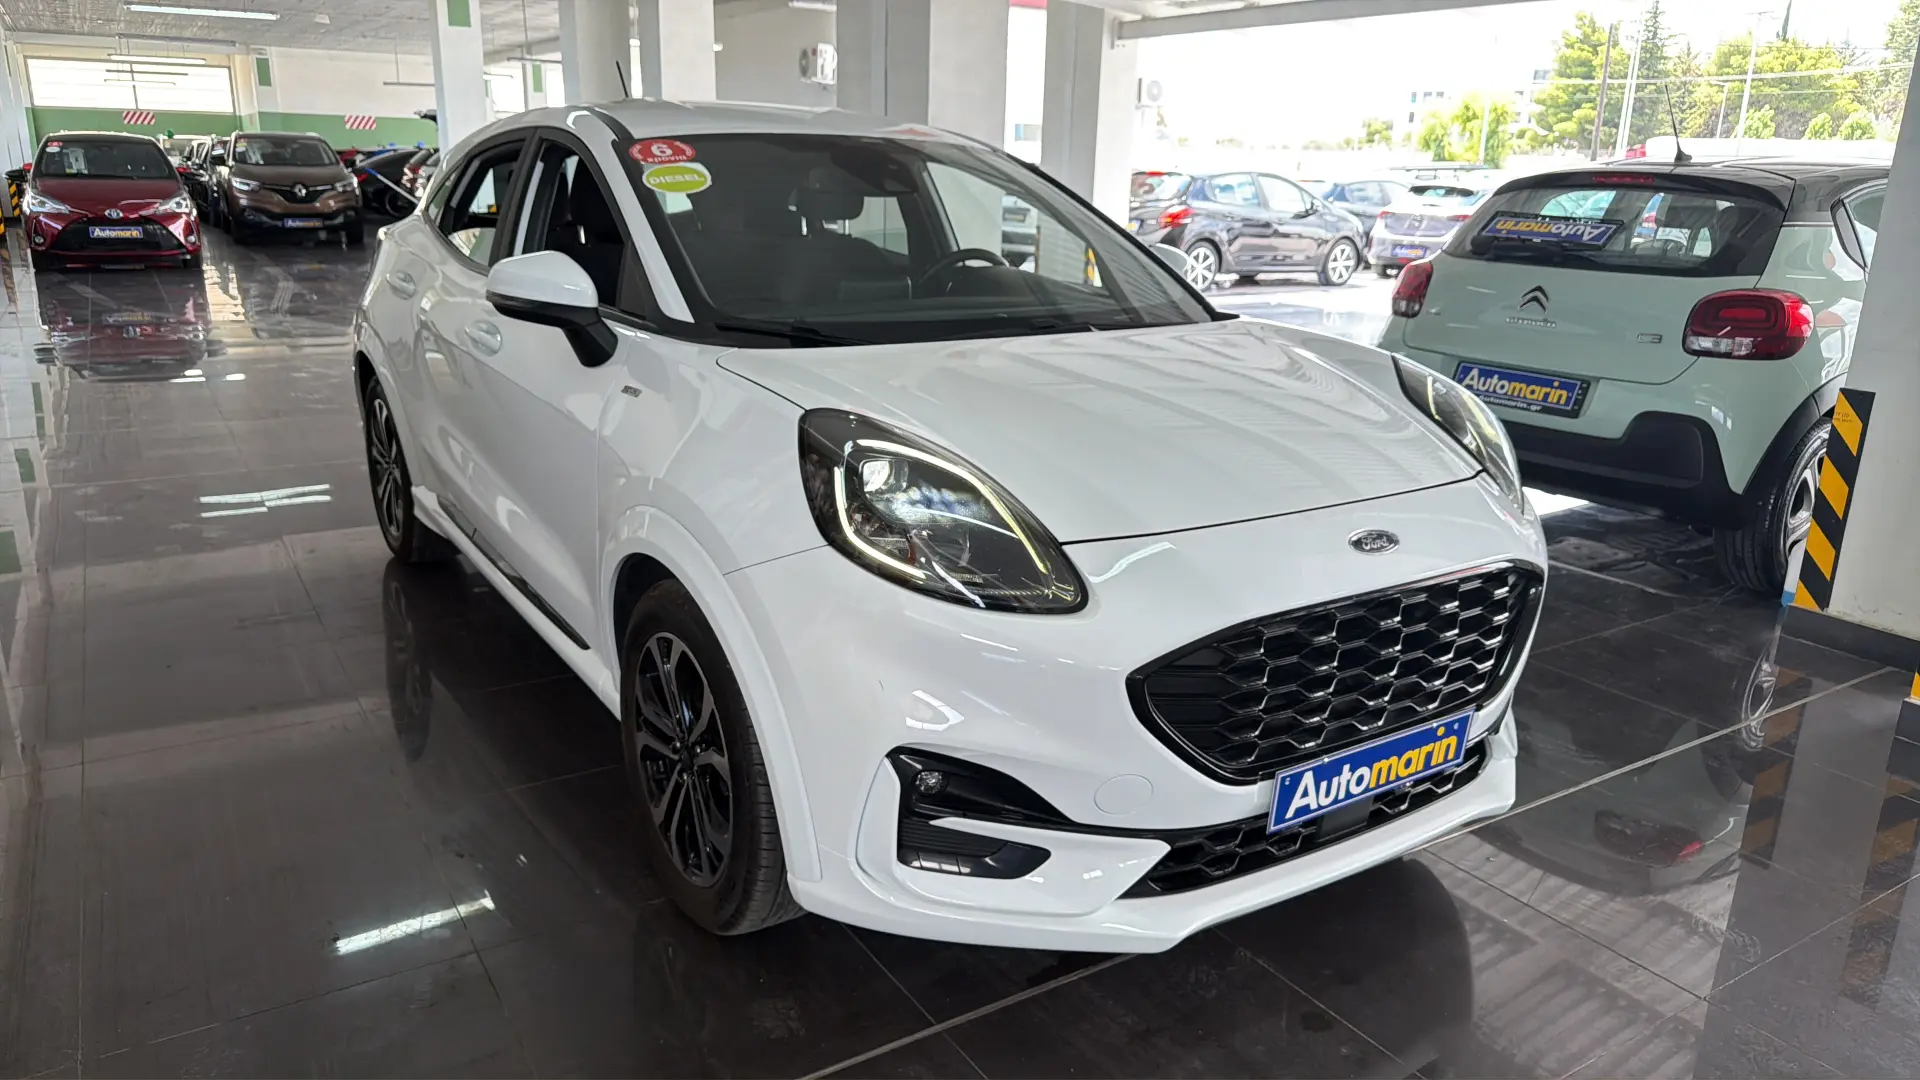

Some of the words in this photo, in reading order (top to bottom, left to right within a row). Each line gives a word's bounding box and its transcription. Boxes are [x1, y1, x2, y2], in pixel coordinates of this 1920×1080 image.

[649, 174, 705, 184] DIESEL
[94, 227, 140, 238] Automarin
[1496, 219, 1602, 241] Automarin
[1462, 367, 1568, 405] Automarin
[1361, 532, 1390, 550] Ford
[1284, 727, 1458, 820] Automarin
